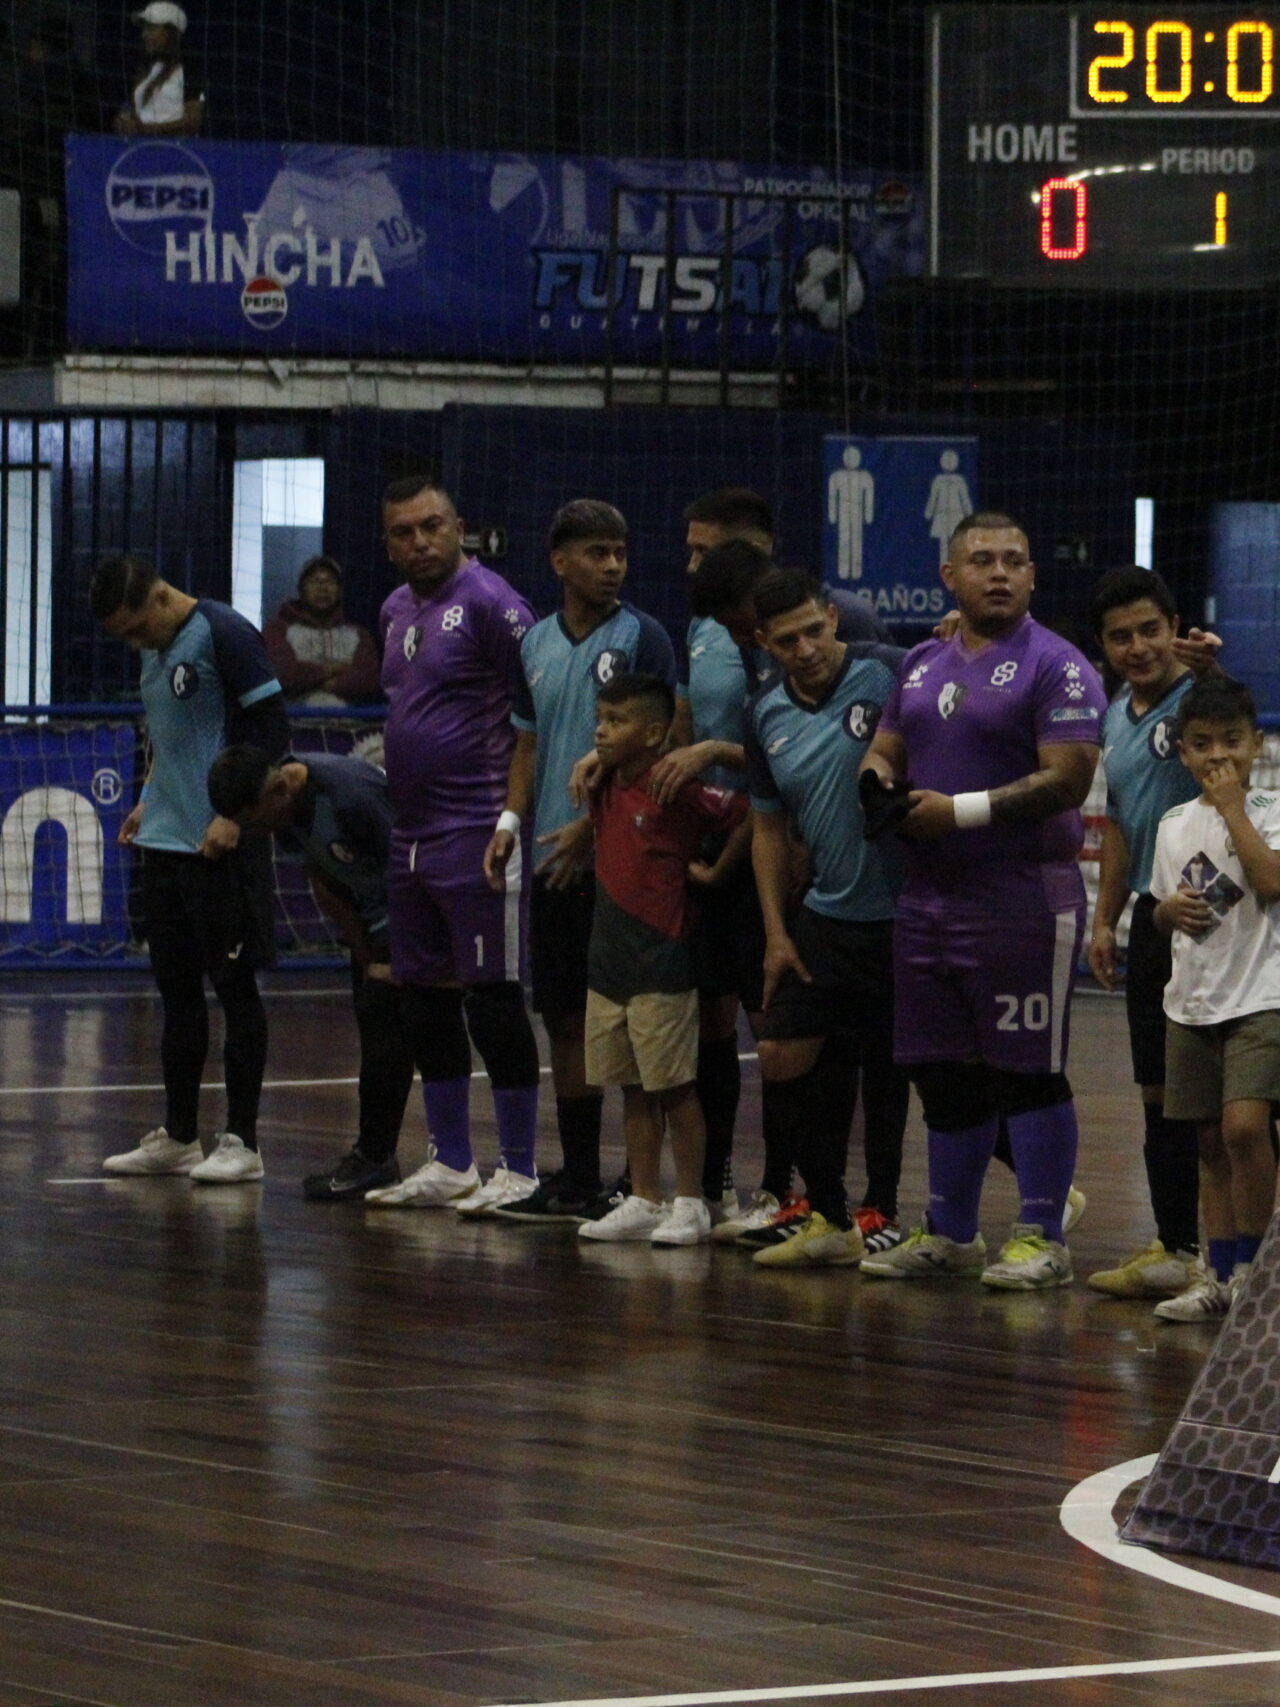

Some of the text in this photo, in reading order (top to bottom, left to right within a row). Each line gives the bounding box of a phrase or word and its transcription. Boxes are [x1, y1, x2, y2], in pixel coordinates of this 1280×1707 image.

[967, 123, 1079, 164] HOME
[1161, 147, 1256, 175] PERIOD
[110, 183, 210, 211] PEPSI
[797, 201, 870, 223] OFICAL
[1041, 178, 1087, 260] 0
[1214, 191, 1228, 246] 1
[165, 222, 386, 289] HINCHA
[244, 296, 286, 309] PEPSI
[473, 934, 485, 968] 1
[994, 993, 1049, 1031] 20
